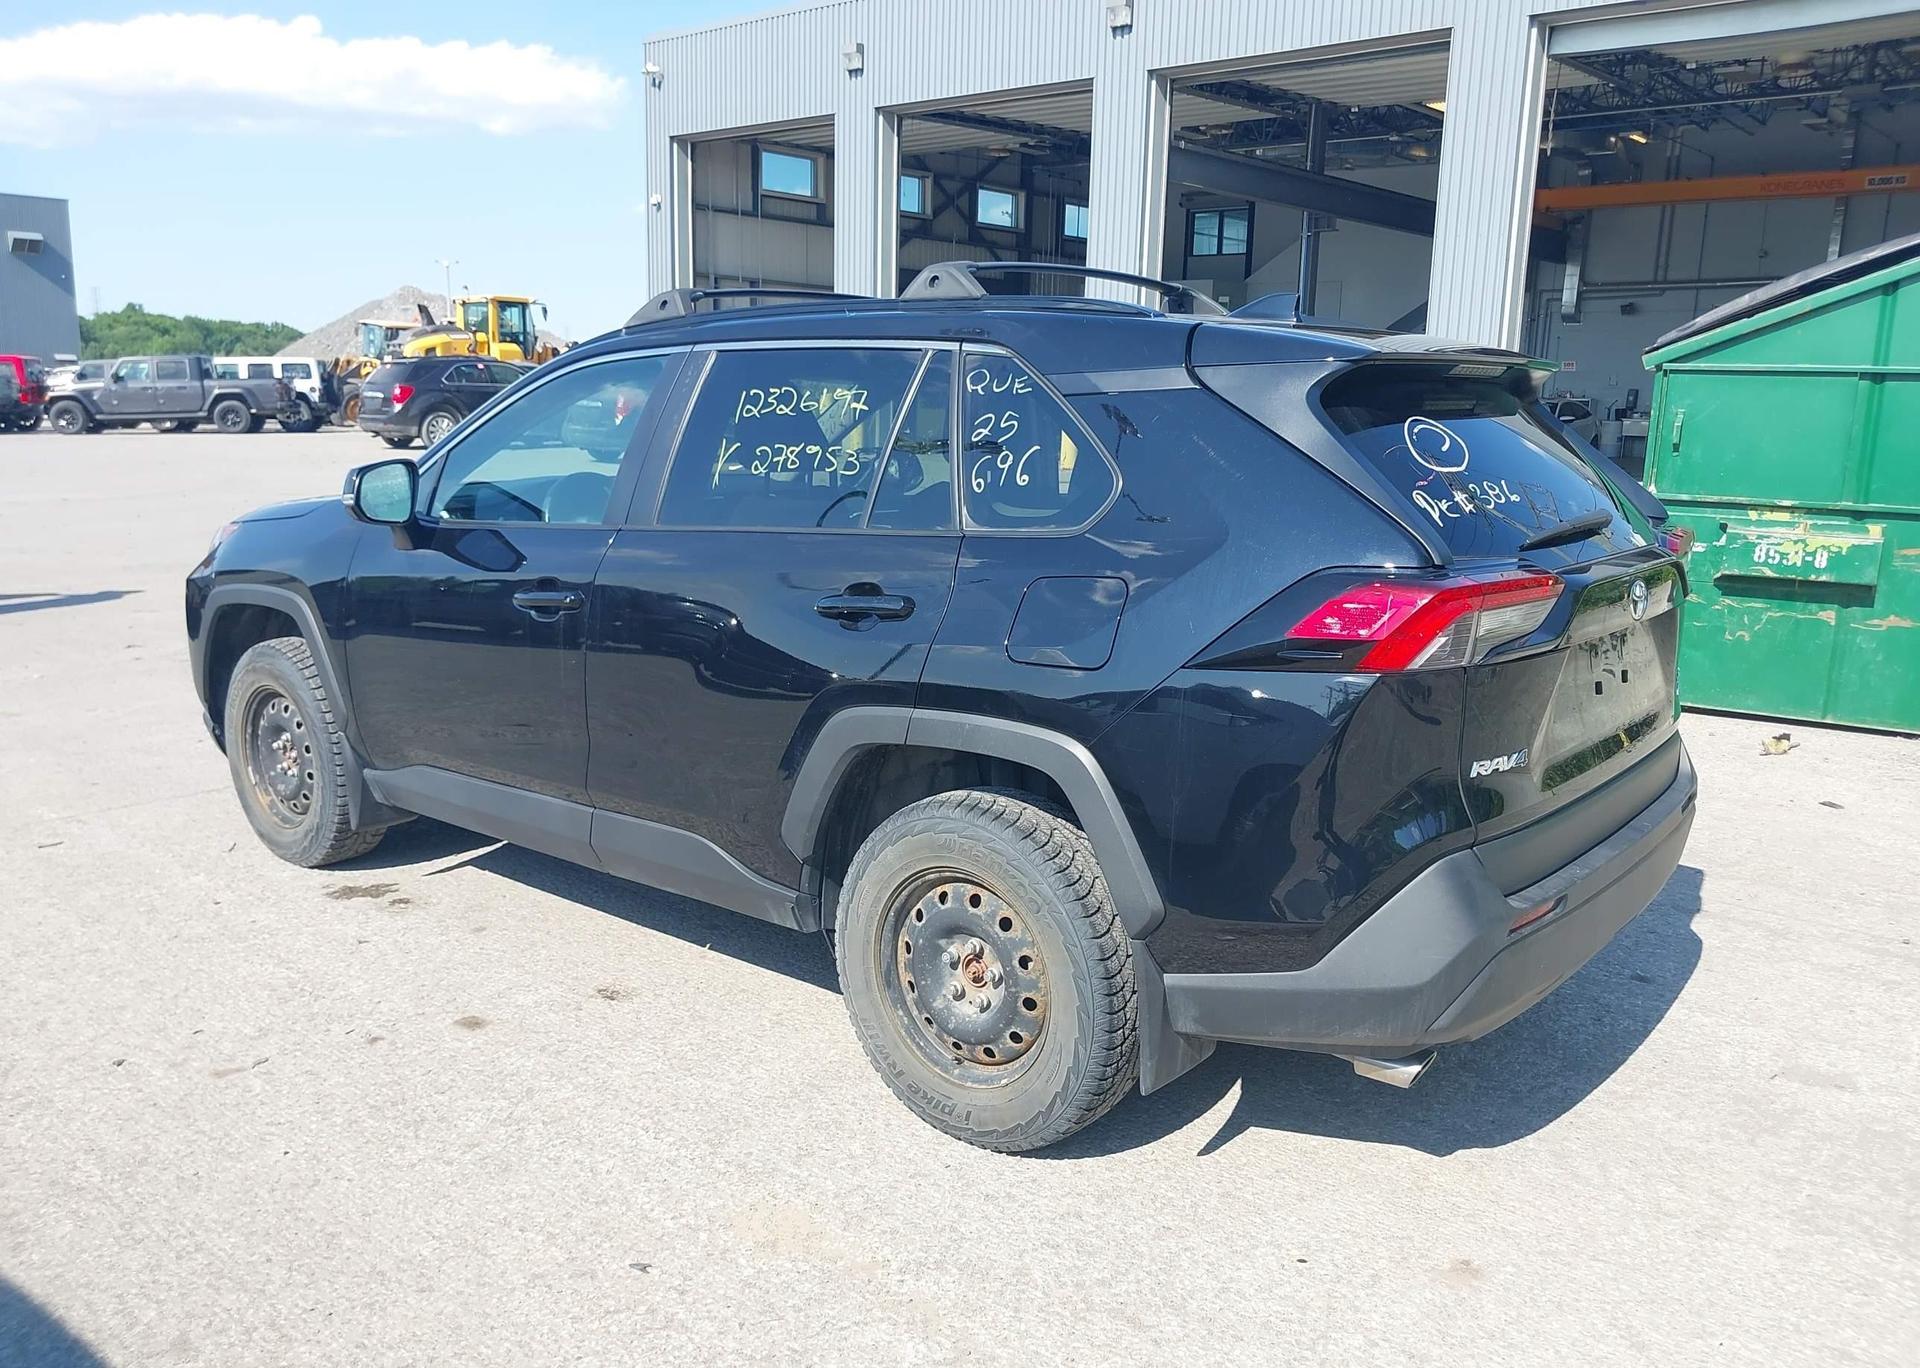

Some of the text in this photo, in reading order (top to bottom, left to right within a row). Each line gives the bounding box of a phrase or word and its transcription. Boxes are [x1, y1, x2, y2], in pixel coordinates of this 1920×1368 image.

[971, 411, 1020, 443] 25
[971, 445, 1041, 493] 696
[1470, 748, 1529, 778] RAV4
